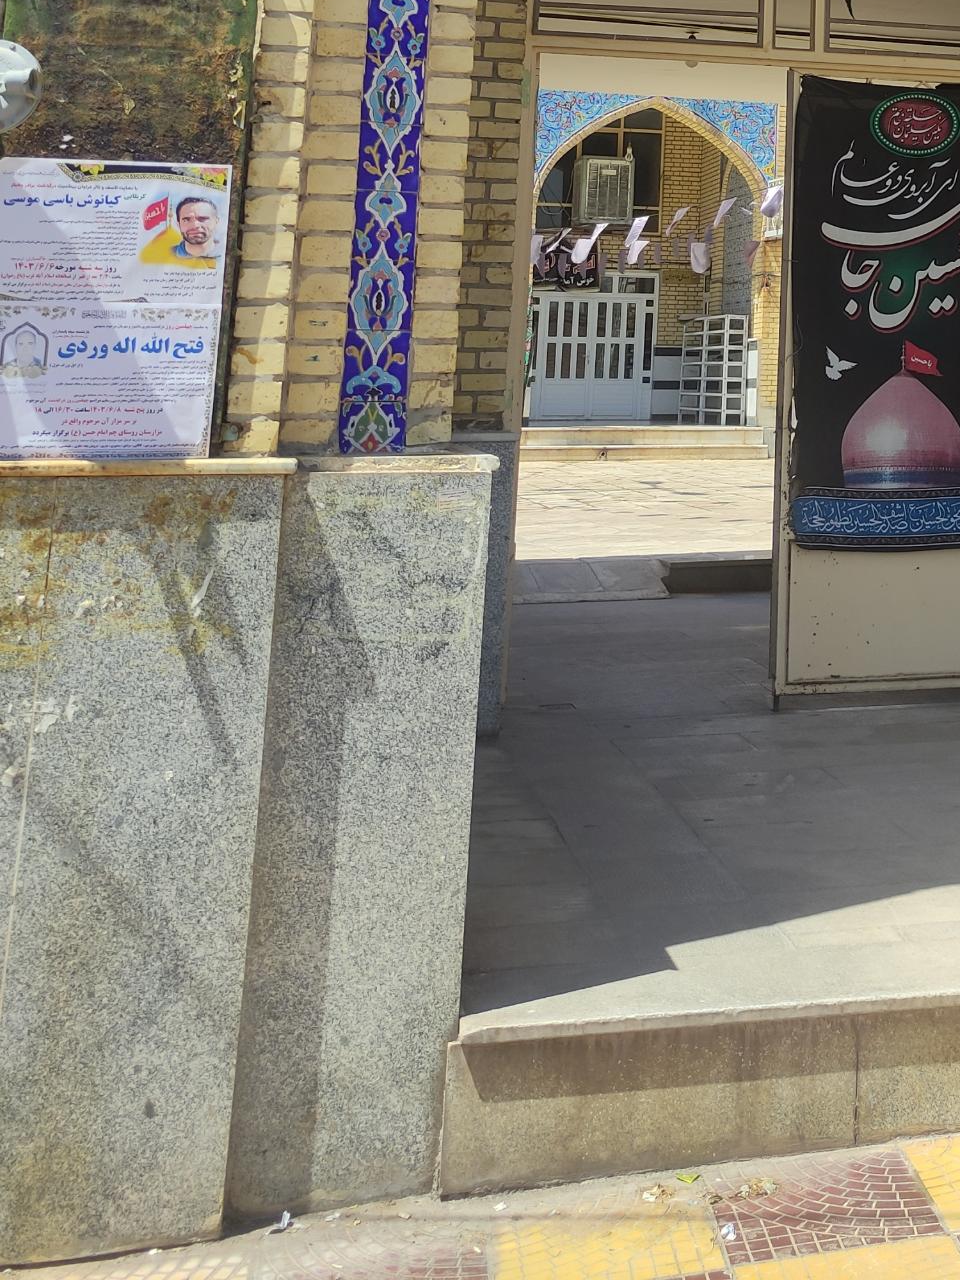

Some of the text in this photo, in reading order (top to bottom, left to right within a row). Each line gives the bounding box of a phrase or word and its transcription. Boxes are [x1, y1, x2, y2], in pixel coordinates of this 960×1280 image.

[831, 139, 900, 197] عالم
[842, 157, 951, 207] آبروی
[76, 193, 121, 208] کیانوش
[57, 332, 205, 360] فتح الله اله وردی
